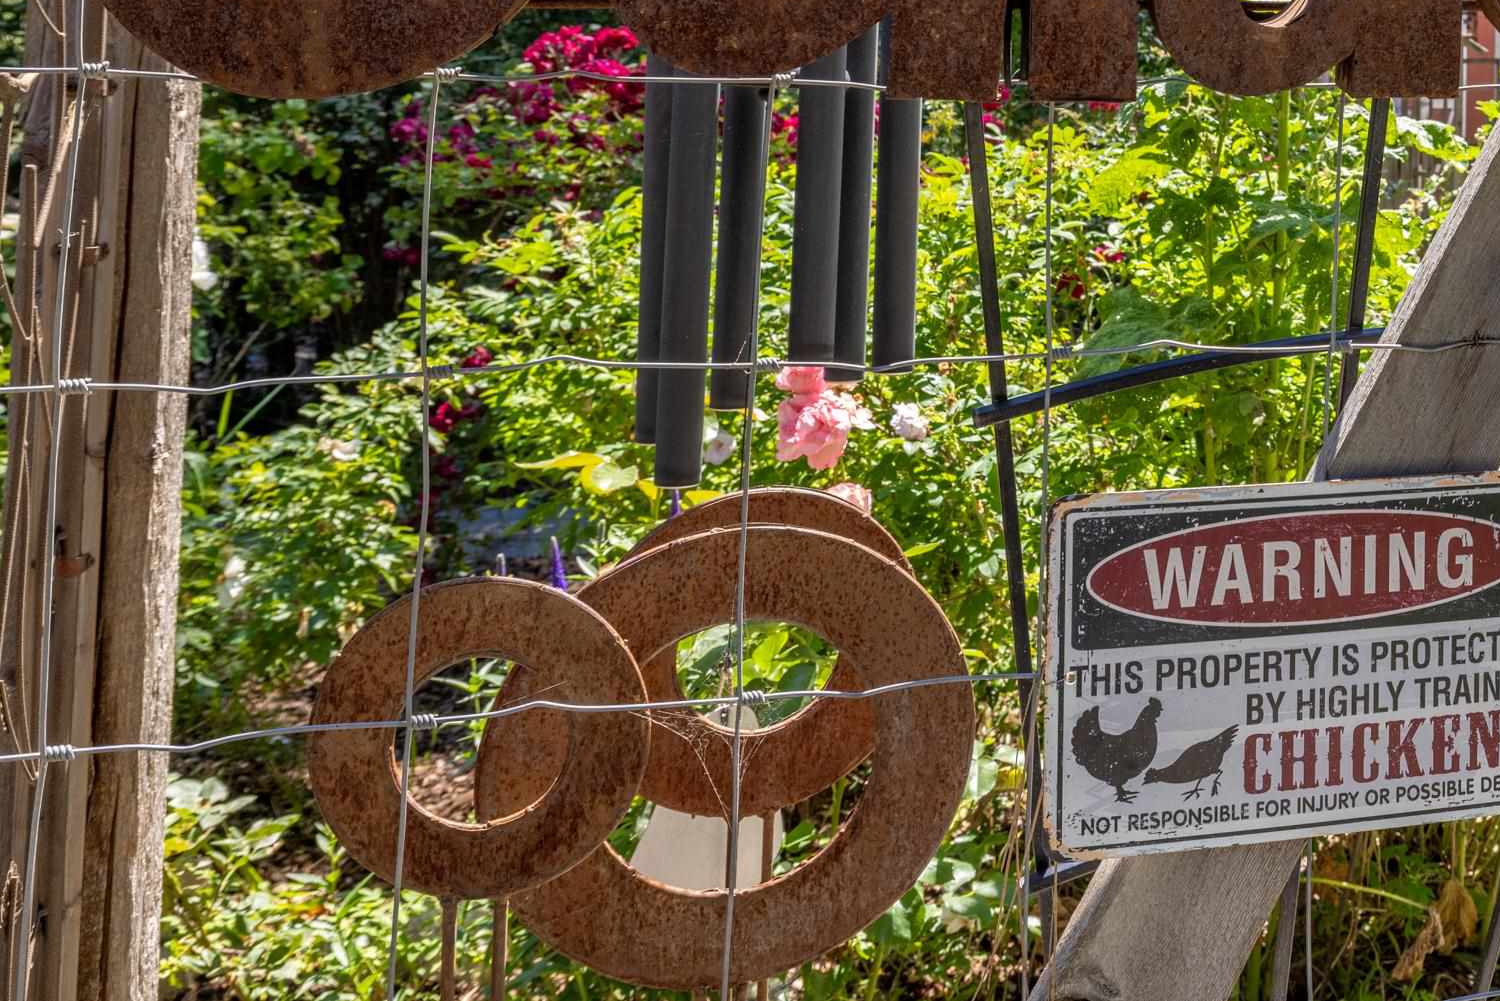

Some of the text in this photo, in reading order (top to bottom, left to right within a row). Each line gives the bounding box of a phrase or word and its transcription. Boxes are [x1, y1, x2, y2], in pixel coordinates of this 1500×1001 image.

[1143, 527, 1475, 611] WARNING
[1070, 660, 1144, 698] THIS
[1155, 646, 1323, 692] PROPERTY
[1332, 643, 1360, 677] IS
[1246, 691, 1286, 726] BY
[1296, 679, 1406, 721] HIGHLY
[1080, 815, 1122, 836] NOT
[1127, 803, 1249, 831] RESPONSIBLE
[1255, 797, 1291, 818] FOR
[1296, 791, 1359, 814] INJURY
[1365, 787, 1391, 805] OR
[1395, 777, 1475, 804] POSSIBLE
